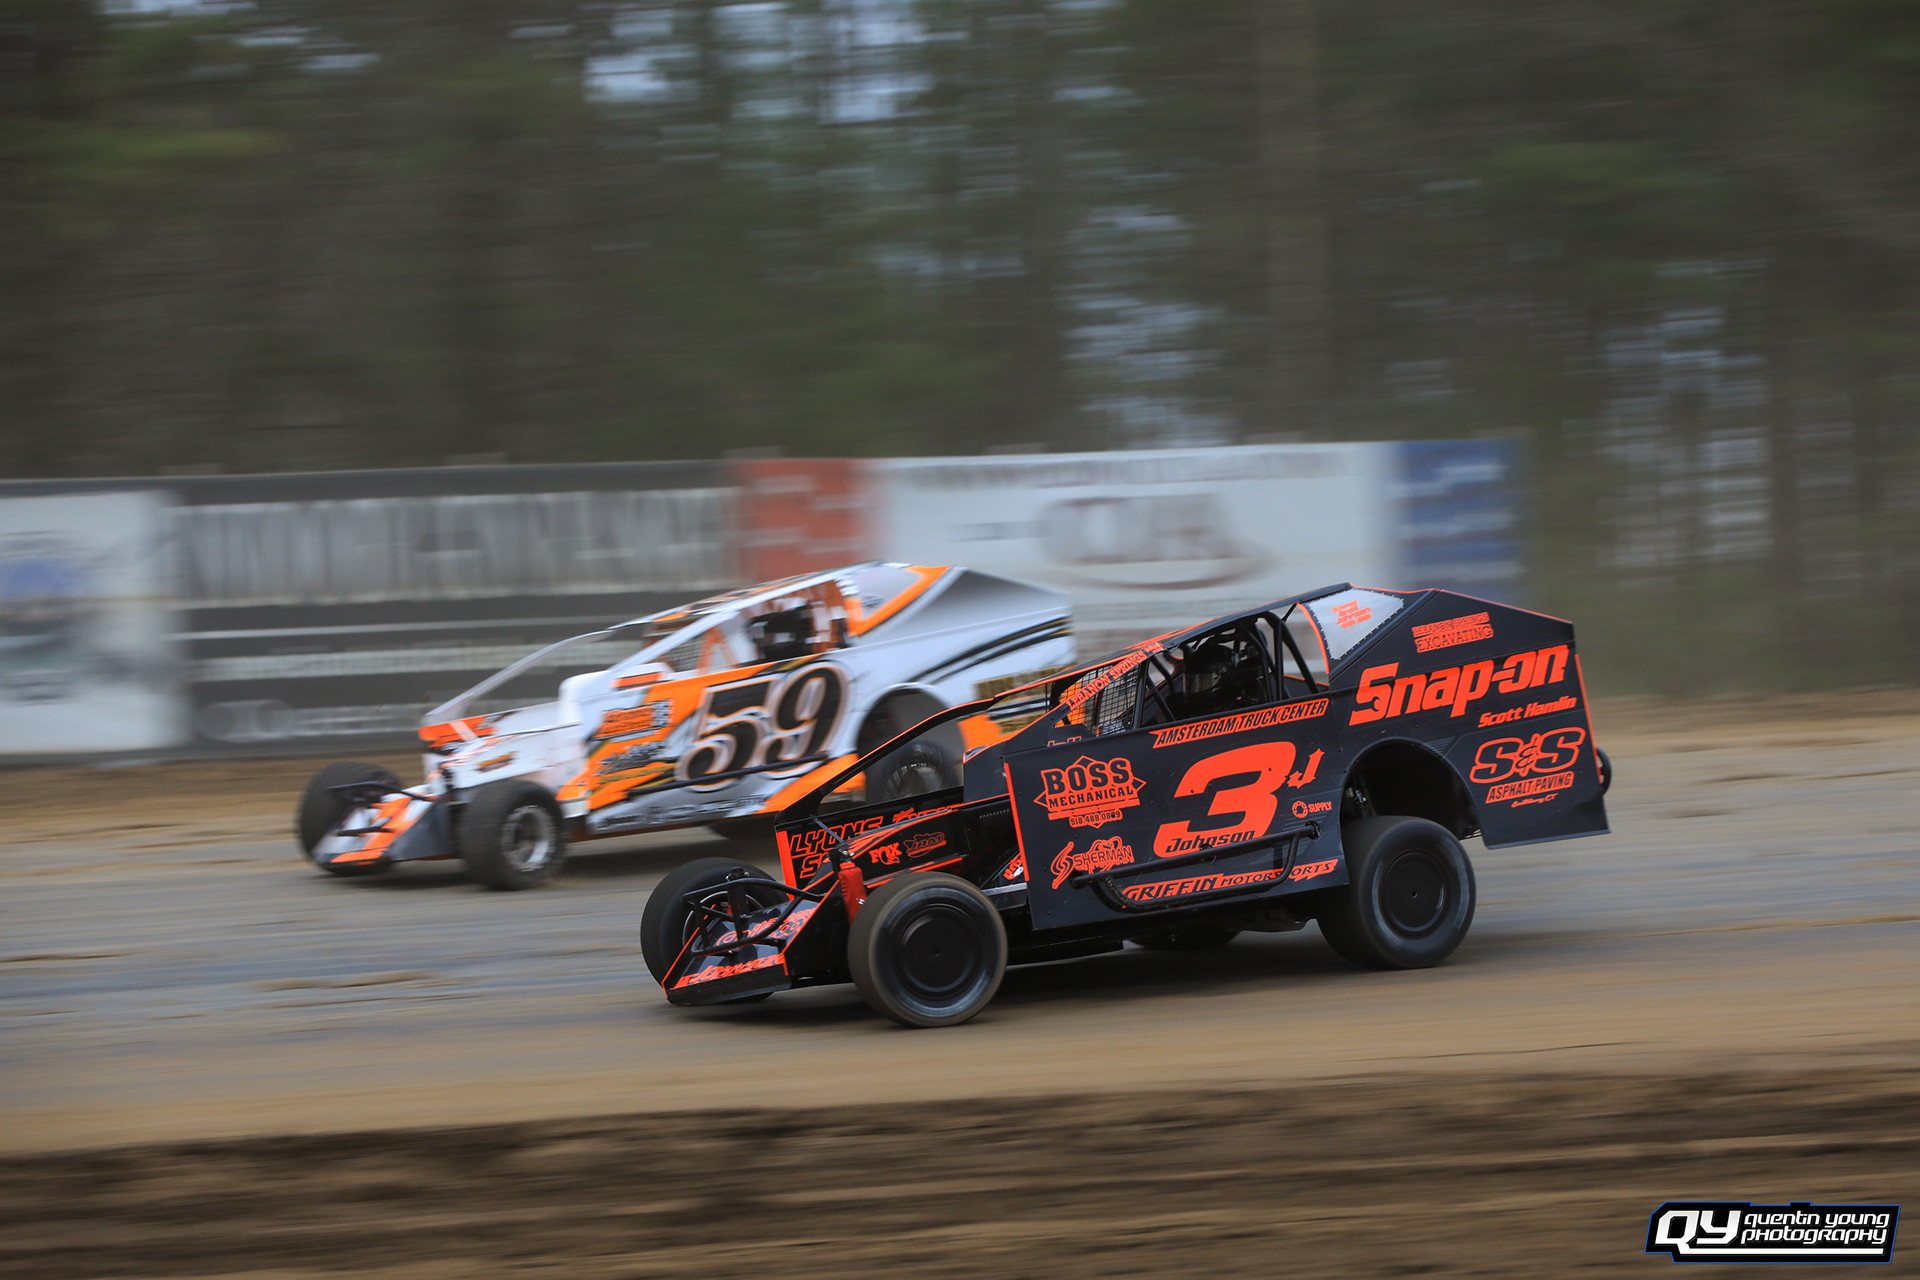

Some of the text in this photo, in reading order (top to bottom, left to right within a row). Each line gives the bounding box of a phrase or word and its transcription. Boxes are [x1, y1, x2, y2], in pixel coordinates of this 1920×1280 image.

[1453, 612, 1489, 628] SPRINGS
[1417, 626, 1493, 651] EXCAVATING
[1067, 674, 1110, 710] LEBANON
[1111, 650, 1146, 680] SPRINGS
[1349, 644, 1569, 726] Snap-on
[680, 662, 848, 790] 59
[1156, 700, 1328, 744] AMSTERDAM TRUCK CENTER
[1478, 696, 1577, 728] Scott Hamlin
[1469, 727, 1586, 783] S&S
[1045, 758, 1132, 794] BOSS
[1489, 773, 1572, 801] ASPHALT PAVING
[1049, 785, 1135, 809] MECHANICAL
[1308, 801, 1332, 813] SUPPLY
[869, 841, 902, 865] FOX
[1073, 846, 1132, 867] SHERMAN
[1165, 830, 1256, 853] Johnson
[1124, 861, 1338, 901] GRIFFIN MOTORSORTS
